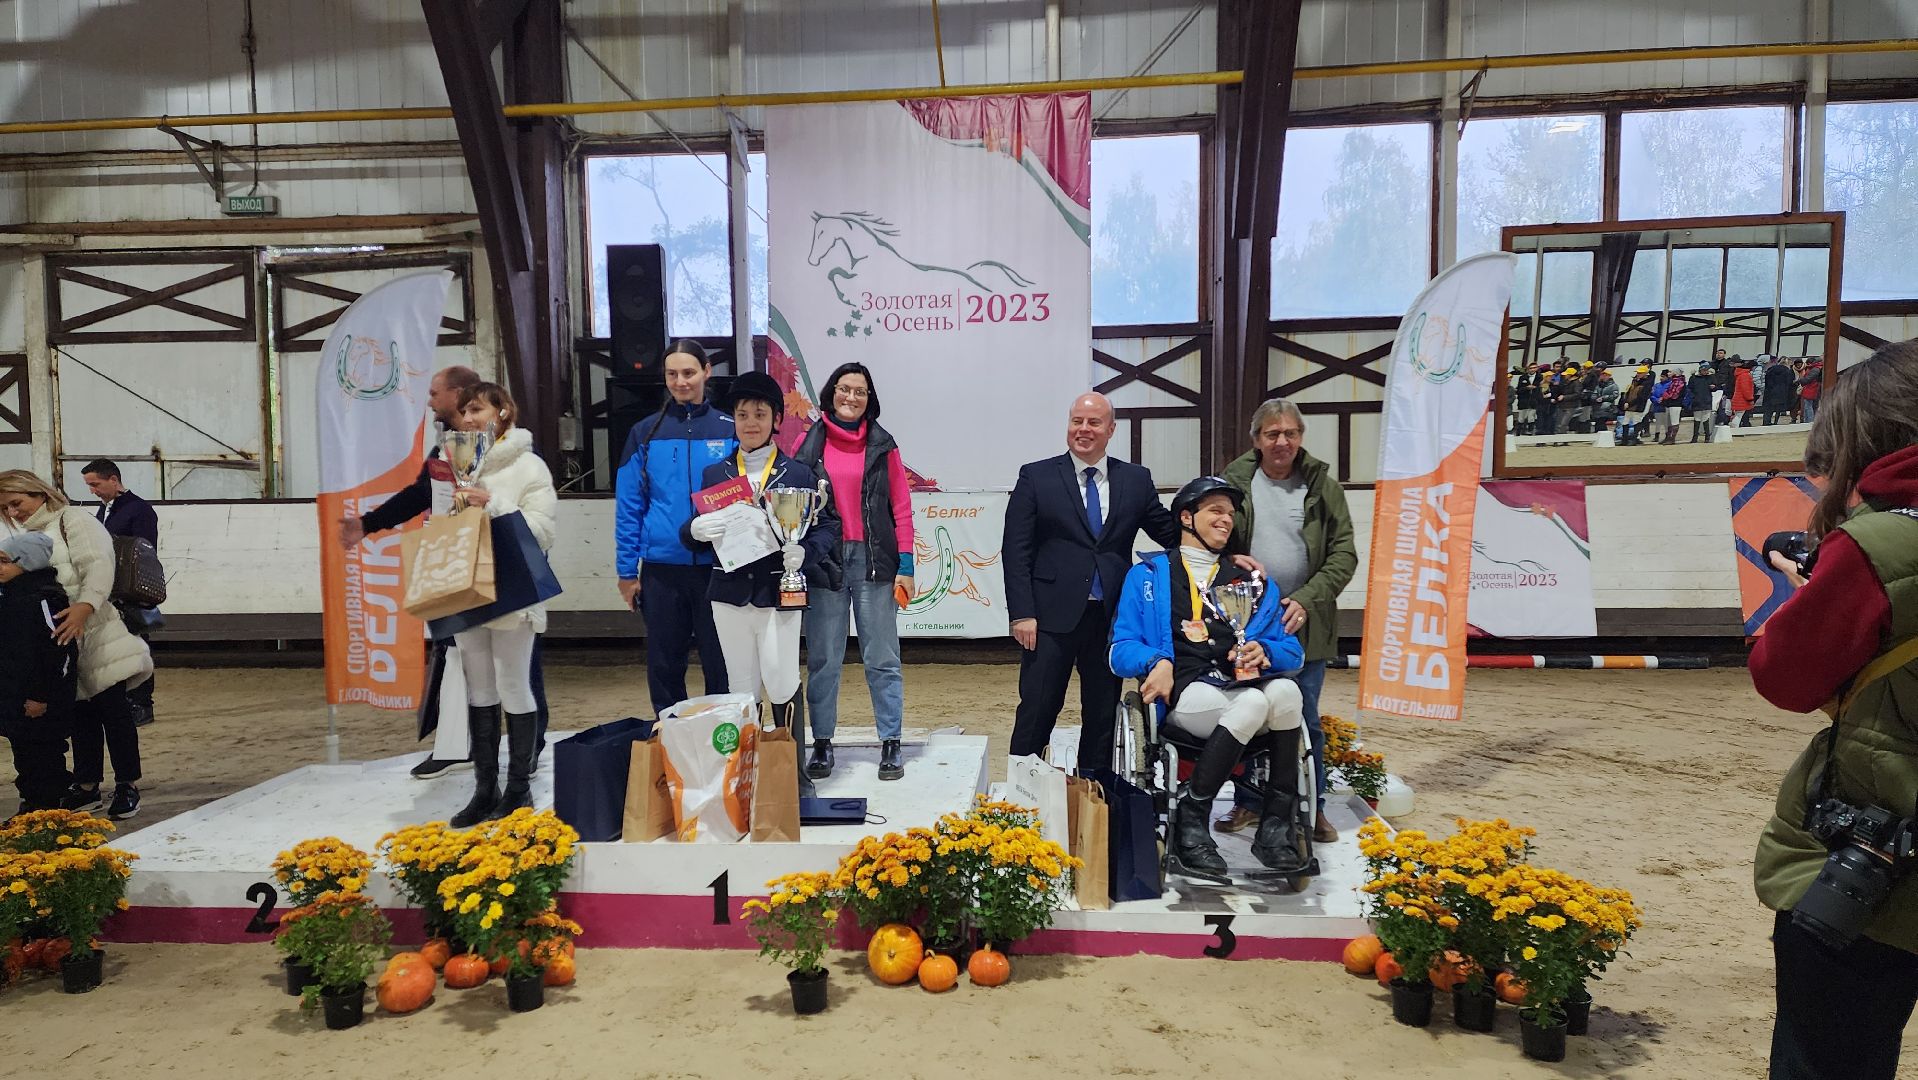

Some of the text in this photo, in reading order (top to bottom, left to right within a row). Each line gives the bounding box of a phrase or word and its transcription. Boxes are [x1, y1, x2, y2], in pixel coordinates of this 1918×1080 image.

[231, 199, 262, 211] ВЫХОД
[861, 291, 1050, 323] Золотая 2023
[884, 313, 953, 332] Осень
[702, 483, 743, 505] Грамота
[1379, 487, 1424, 682] СПОРТИВНАЯ ШКОЛА
[1405, 482, 1454, 690] БЕЛКА
[1470, 572, 1557, 587] Золотая 2023
[1481, 581, 1514, 589] Осень
[343, 563, 367, 675] СПОРТИВНАЯ
[1373, 694, 1459, 720] КОТЕЛЬНИКИ
[245, 881, 281, 934] 2
[705, 869, 731, 925] 1
[1203, 914, 1236, 959] 3
